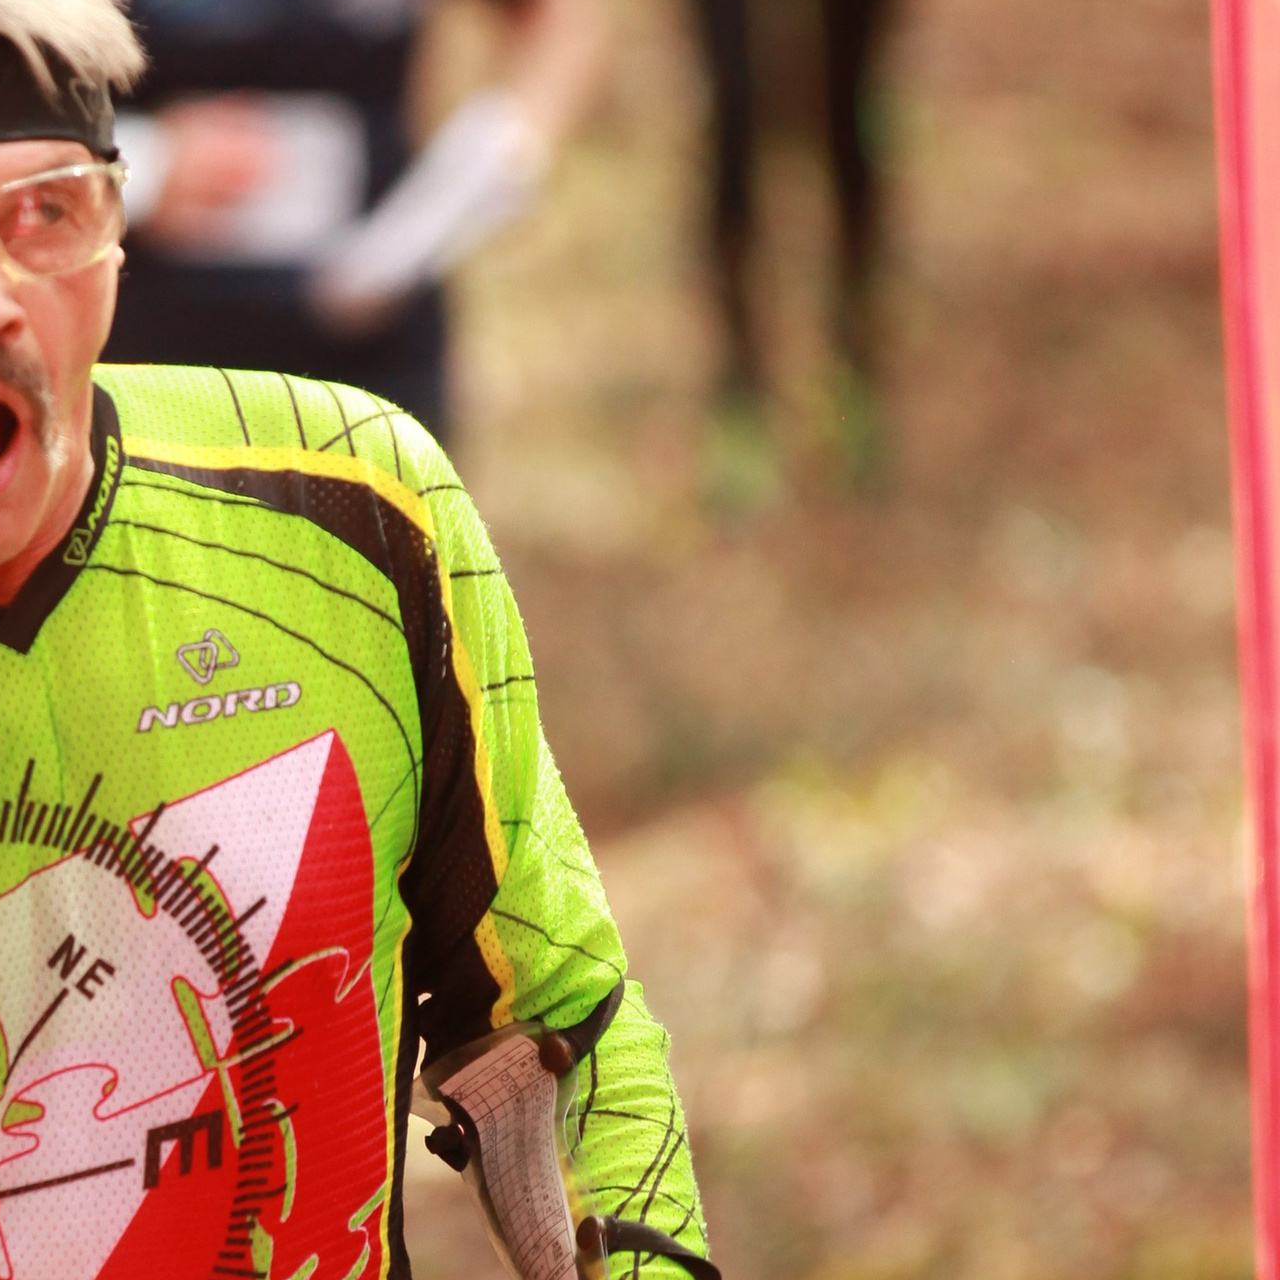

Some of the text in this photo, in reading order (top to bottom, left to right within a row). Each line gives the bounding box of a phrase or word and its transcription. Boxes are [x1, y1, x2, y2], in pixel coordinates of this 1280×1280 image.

[88, 434, 119, 532] NORD
[136, 681, 302, 734] NORD
[46, 933, 117, 1003] NE
[143, 1110, 224, 1189] E
